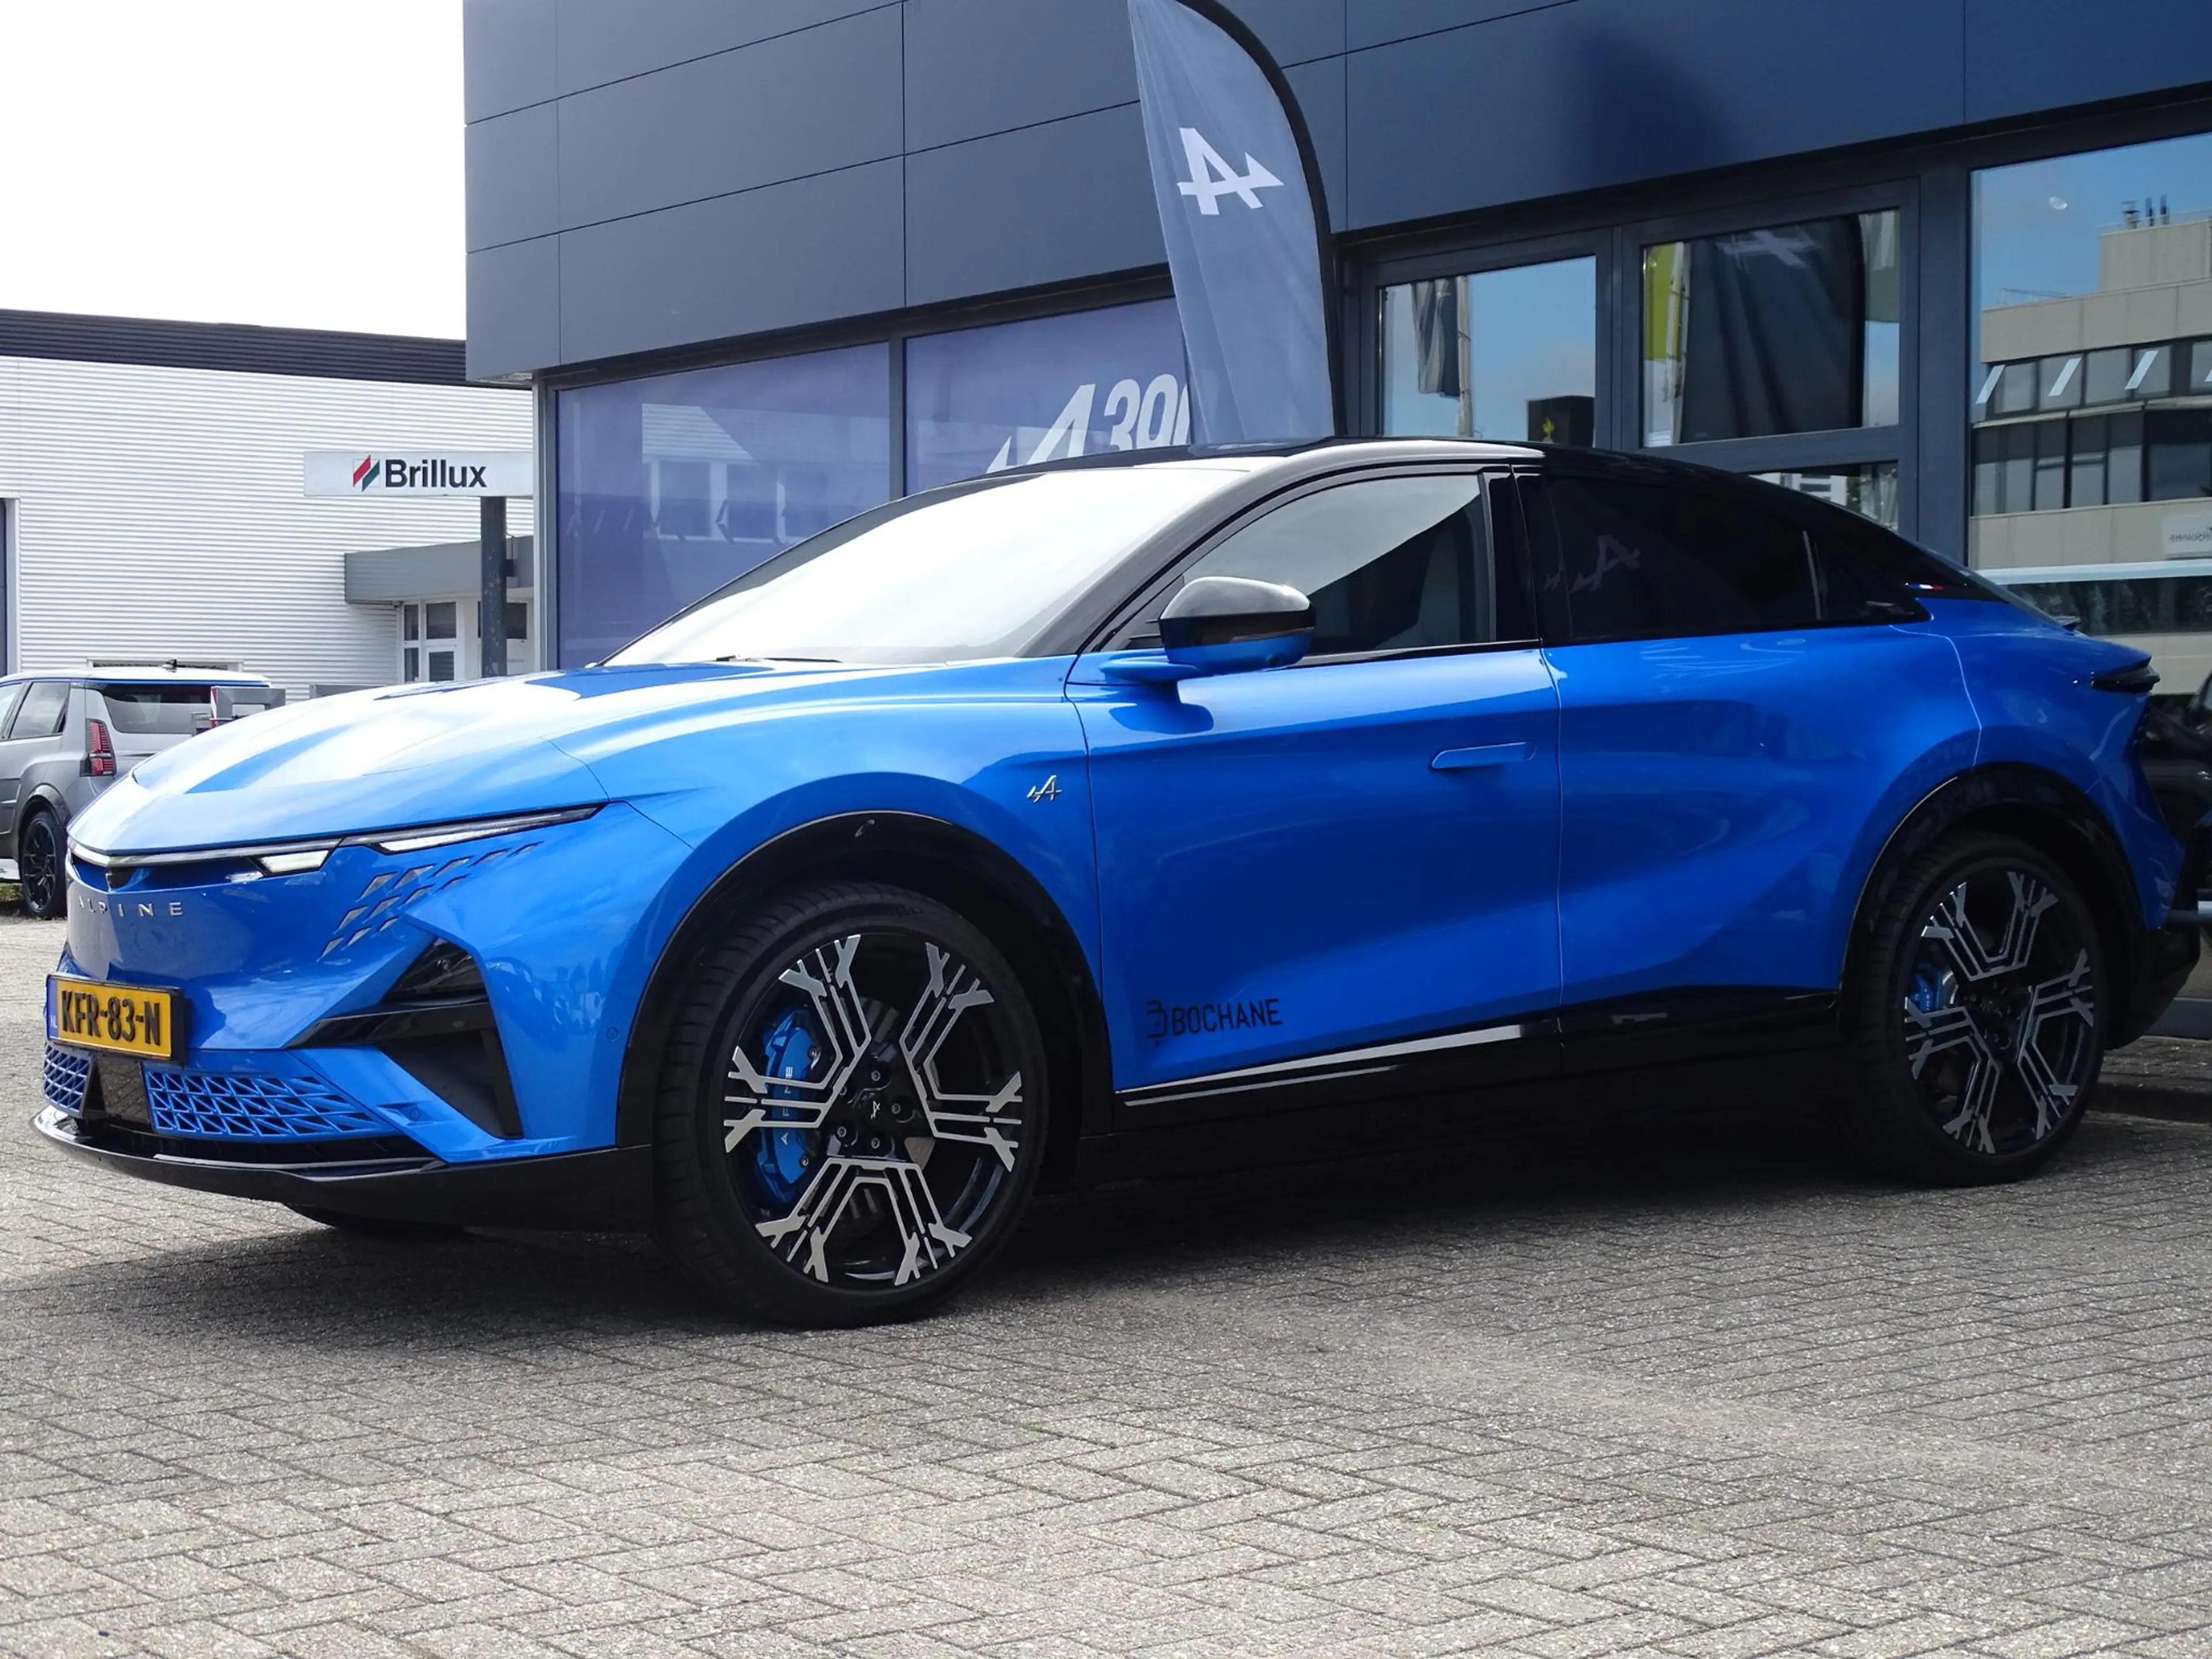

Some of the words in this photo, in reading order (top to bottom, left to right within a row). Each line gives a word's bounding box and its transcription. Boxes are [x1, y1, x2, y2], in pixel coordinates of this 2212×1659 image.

[385, 459, 487, 488] Brillux
[78, 894, 183, 917] ALPINE
[61, 990, 161, 1047] KFR-83-N
[1172, 998, 1283, 1036] BOCHANE
